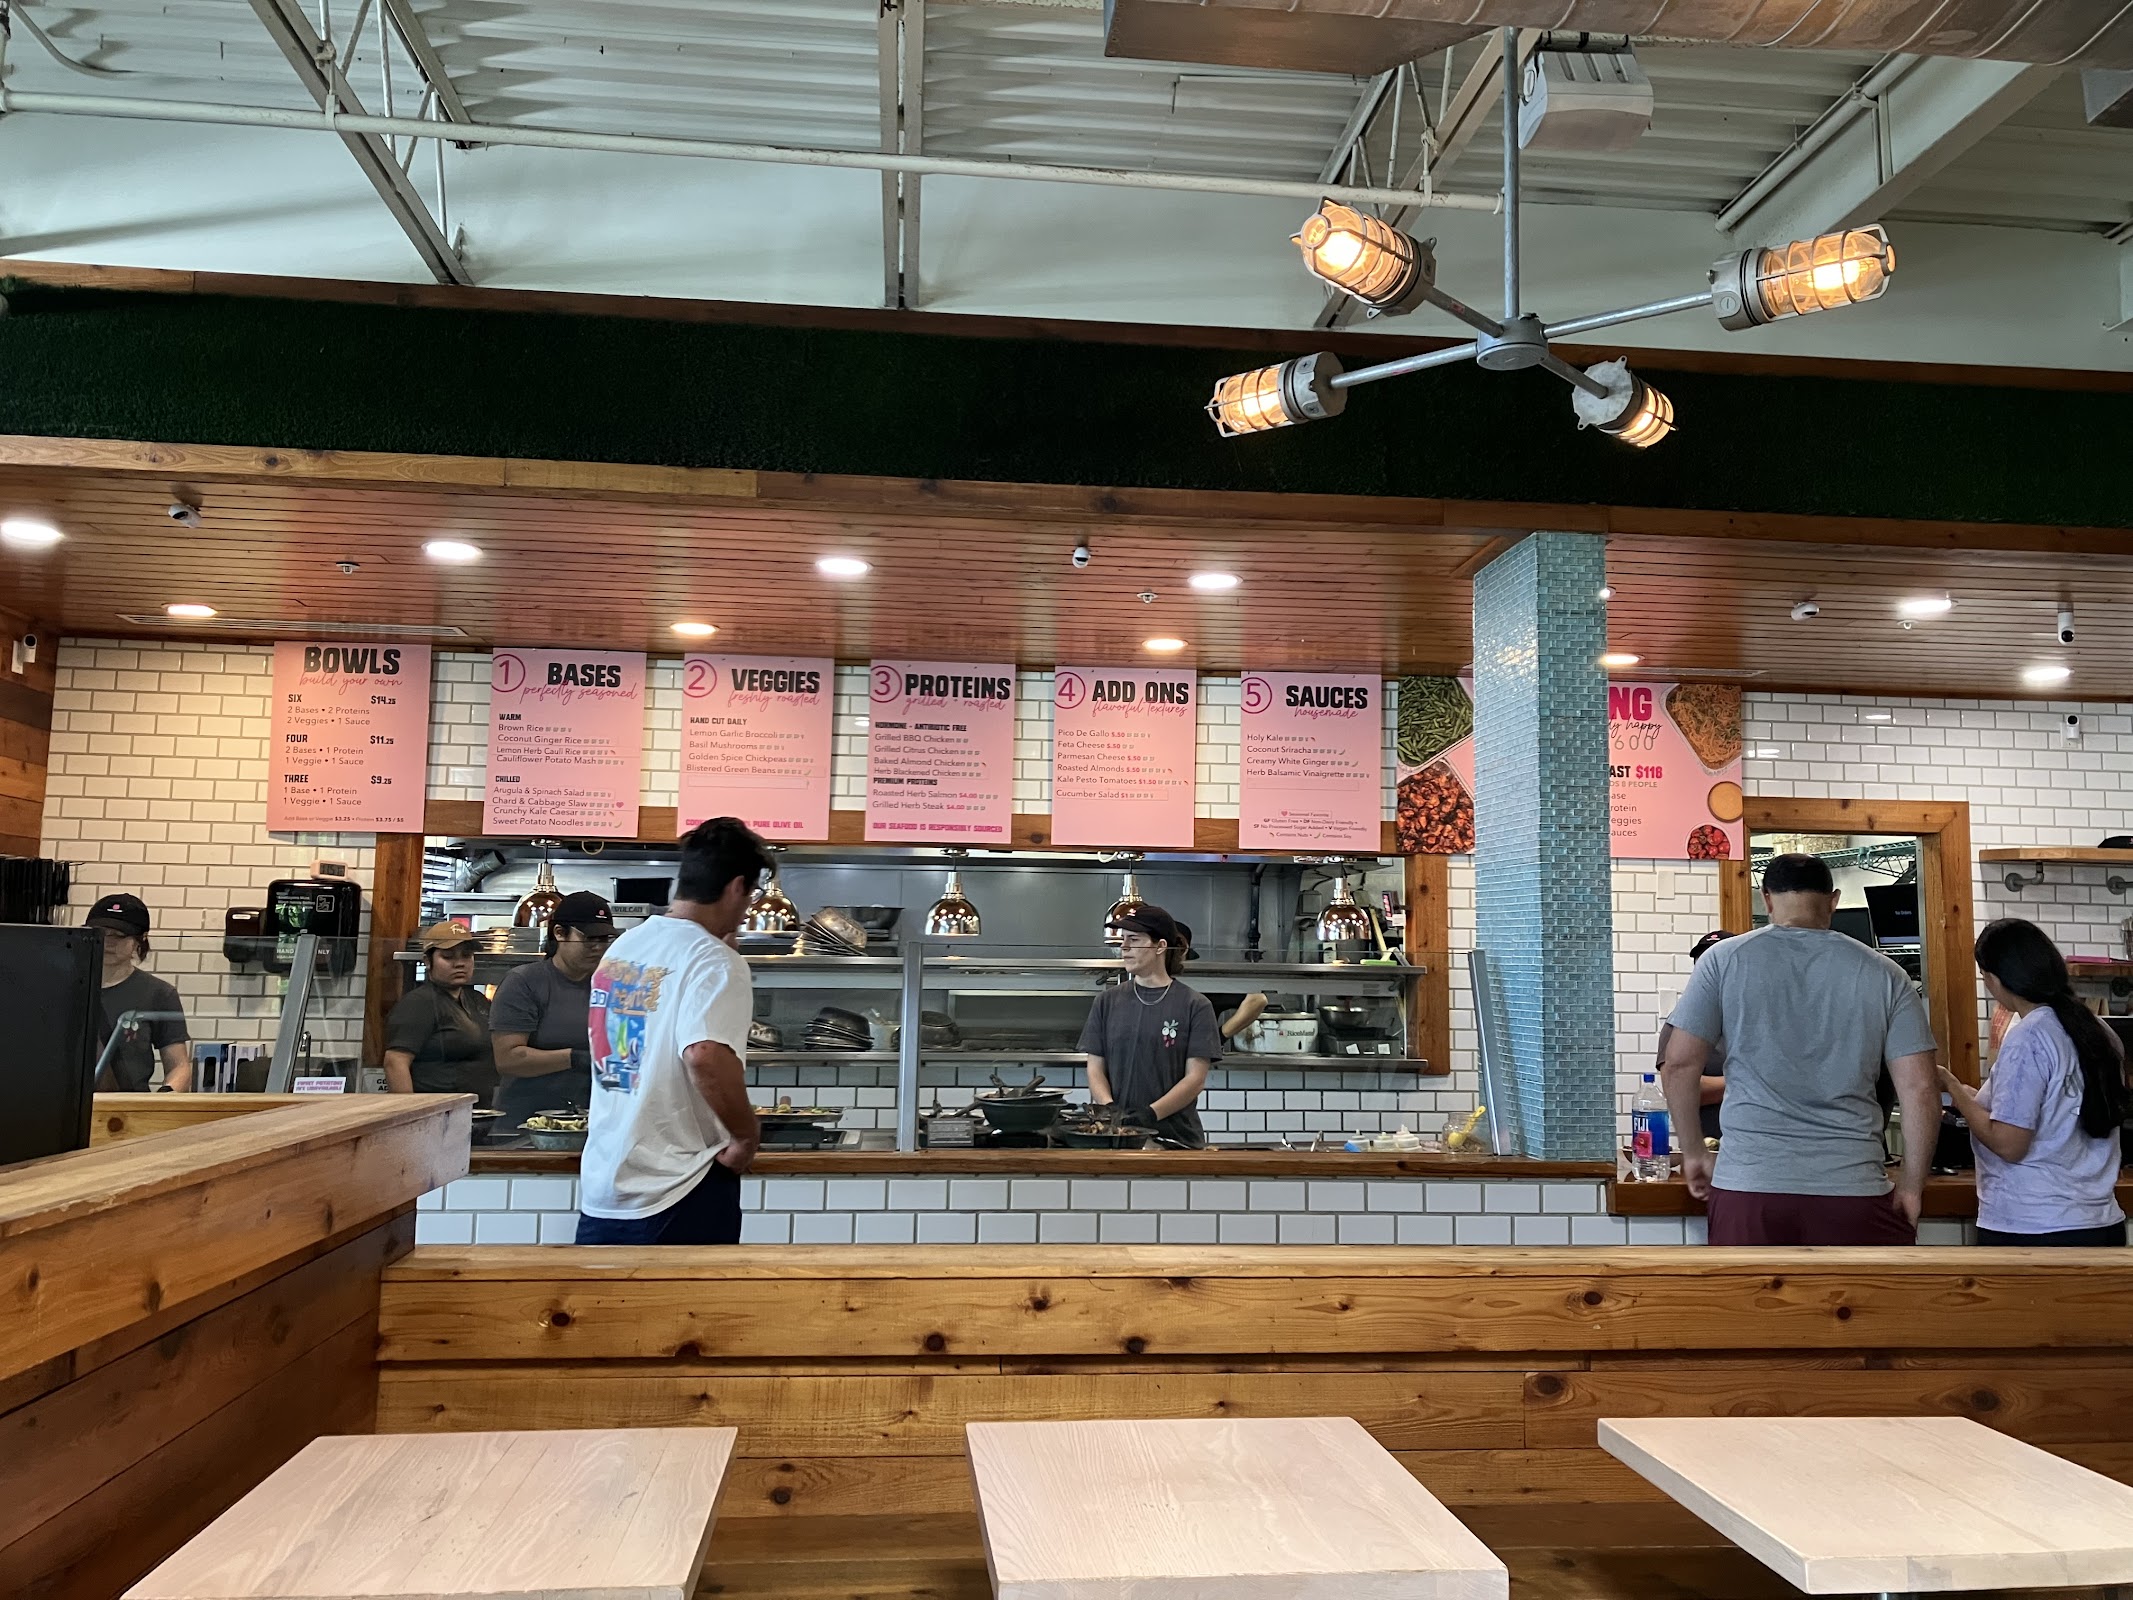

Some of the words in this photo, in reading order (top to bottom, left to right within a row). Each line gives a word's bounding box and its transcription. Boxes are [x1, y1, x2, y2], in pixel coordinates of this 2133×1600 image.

[304, 647, 400, 675] BOWLS
[499, 660, 509, 684] 1
[547, 663, 621, 687] BASES
[299, 668, 337, 686] build
[339, 678, 368, 695] your
[374, 678, 403, 686] own
[688, 665, 706, 690] 2
[731, 669, 820, 693] VEGGIES
[875, 671, 890, 695] 3
[905, 674, 1011, 700] PROTEINS
[519, 679, 575, 706] perfectly
[578, 683, 638, 700] seasoned
[1058, 678, 1075, 701] 4
[1092, 681, 1135, 702] ADD
[1146, 682, 1189, 704] ONS
[288, 694, 302, 702] SIX
[1246, 683, 1261, 707] 5
[1286, 685, 1368, 709] SAUCES
[371, 696, 396, 704] $14.25
[728, 689, 771, 712] freshly
[776, 691, 821, 706] roasted
[902, 692, 947, 715] grilled
[964, 697, 1006, 712] roasted
[1609, 687, 1652, 721] NG
[295, 706, 319, 714] Bases
[336, 707, 370, 715] Proteins
[1092, 697, 1144, 718] flavorful
[1144, 700, 1188, 717] textures
[1294, 704, 1358, 720] housemade
[294, 717, 328, 725] Veggies
[1626, 714, 1663, 739] happy
[286, 734, 307, 742] FOUR
[370, 735, 394, 744] $11.25
[498, 734, 532, 742] Coconut
[534, 735, 562, 744] Ginger
[565, 736, 582, 744] Rice
[924, 735, 954, 743] Chicken
[293, 757, 322, 766] Veggie
[496, 755, 543, 763] Cauliflower
[721, 754, 743, 762] Spice
[745, 755, 787, 763] Chickpeas
[935, 759, 965, 767] Chicken
[1247, 758, 1276, 766] Creamy
[1303, 759, 1328, 767] Ginger
[686, 764, 722, 772] Blistered
[1609, 766, 1631, 777] AST
[1636, 765, 1662, 779] $118
[284, 774, 308, 782] THREE
[1303, 770, 1344, 779] Vinaigrette
[371, 776, 392, 784] $9.25
[327, 787, 357, 795] Protein
[494, 787, 522, 796] Arugula
[532, 788, 562, 796] Spinach
[1057, 790, 1096, 798] Cucumber
[290, 797, 319, 806] Veggie
[528, 798, 566, 807] Cabbage
[873, 801, 899, 809] Grilled
[494, 808, 526, 816] Crunchy
[753, 820, 770, 828] PURE
[1611, 817, 1642, 826] eggies
[1634, 1118, 1649, 1131] FIJI
